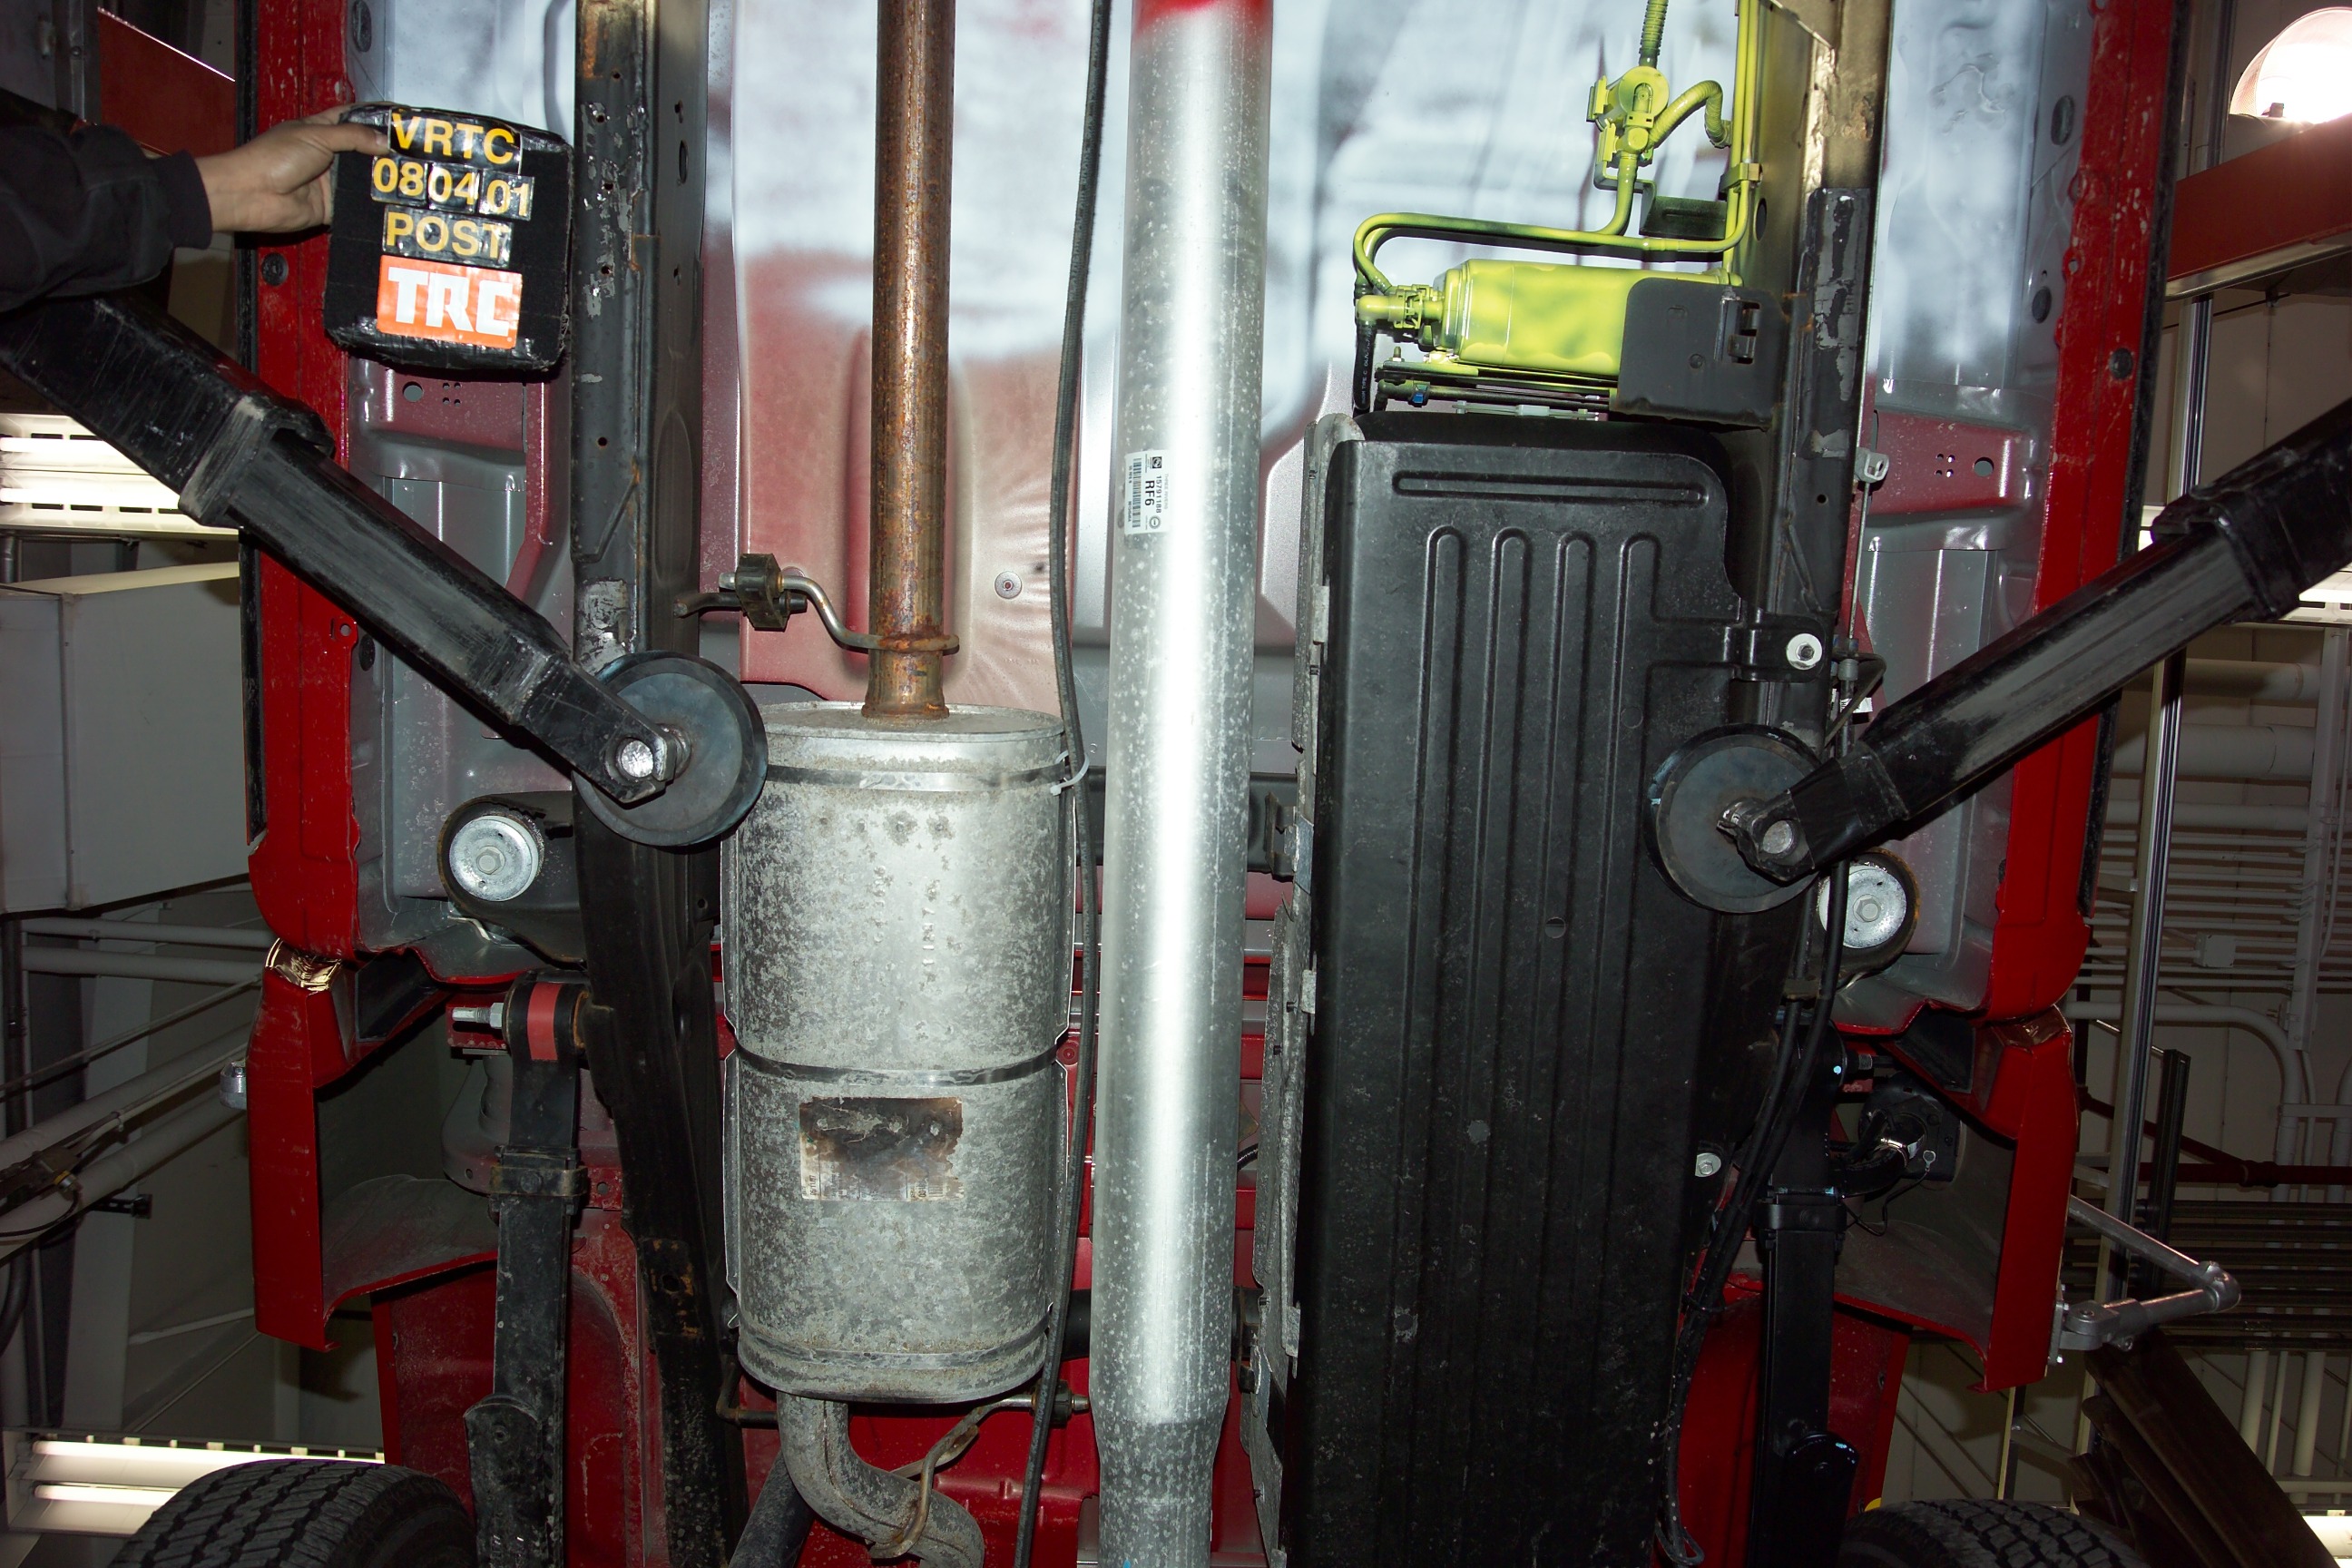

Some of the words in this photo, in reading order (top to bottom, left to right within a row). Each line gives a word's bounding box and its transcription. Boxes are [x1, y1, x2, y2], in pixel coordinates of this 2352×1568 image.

[391, 113, 515, 165] VRTC
[386, 211, 510, 260] POST
[387, 266, 514, 337] TRC
[1144, 480, 1155, 506] RF6
